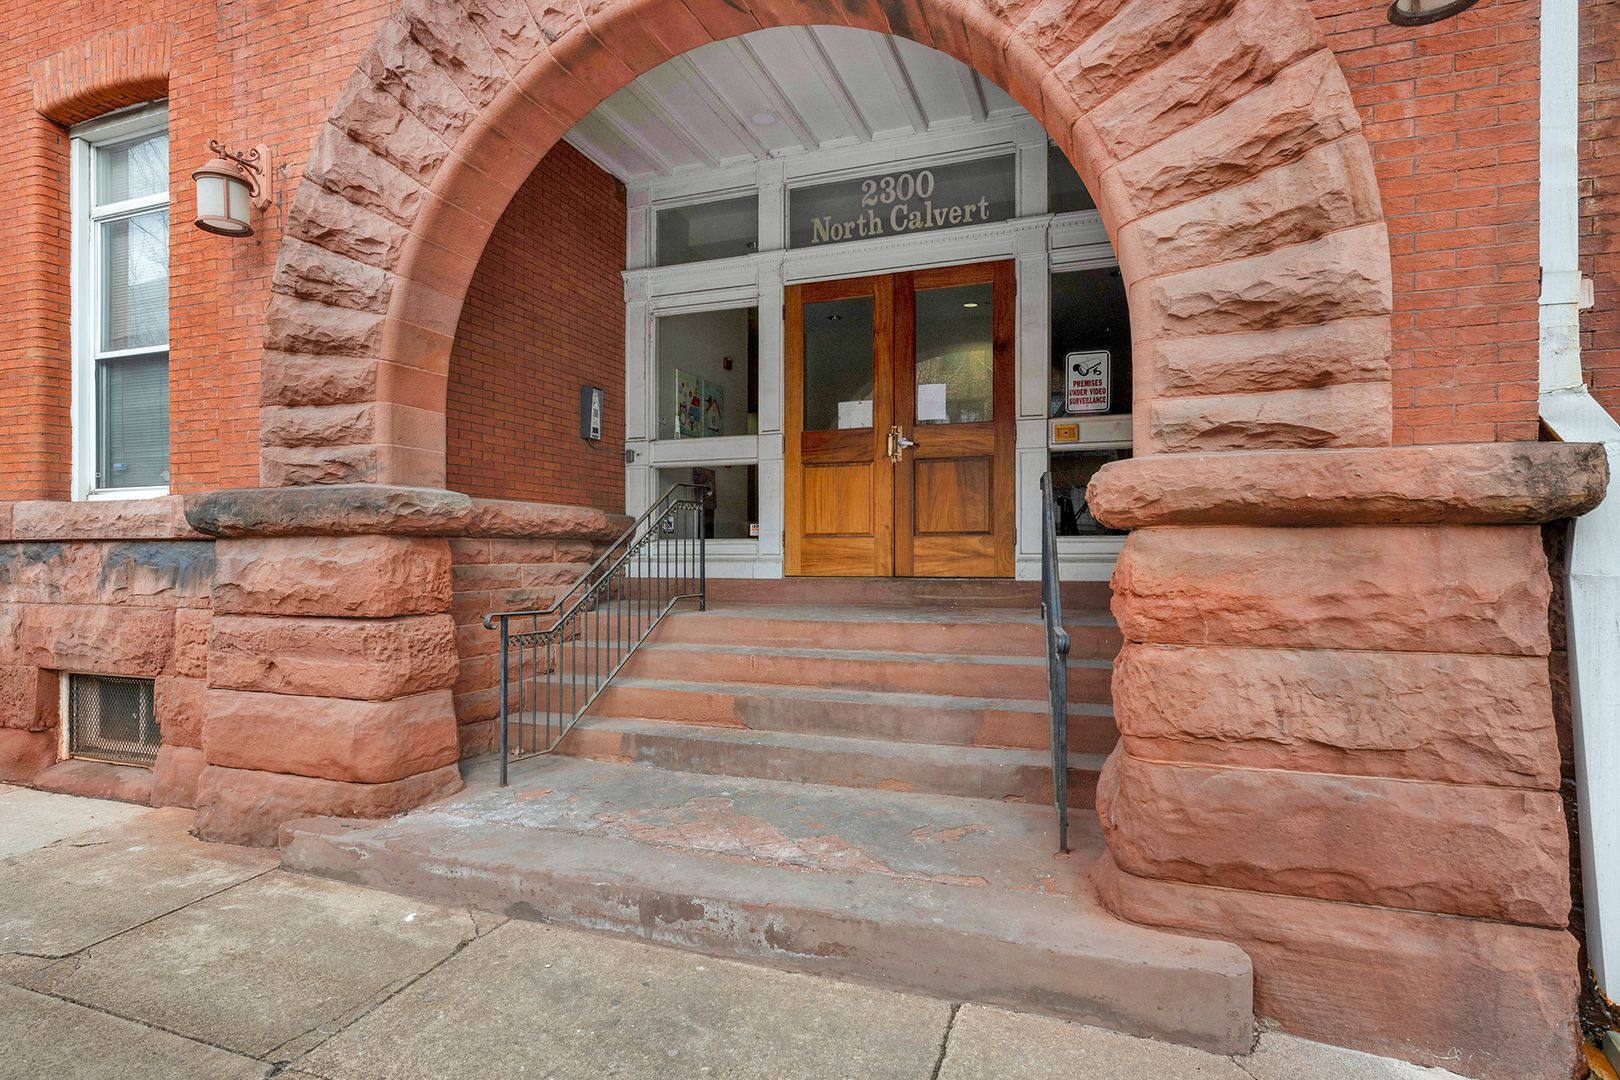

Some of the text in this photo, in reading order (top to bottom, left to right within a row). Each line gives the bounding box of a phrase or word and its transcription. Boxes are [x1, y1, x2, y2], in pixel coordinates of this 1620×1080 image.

[861, 170, 935, 207] 2300
[811, 195, 990, 243] North Calvert
[1072, 379, 1102, 387] PREMISES
[1069, 387, 1106, 396] UNDER VIDEO
[1069, 396, 1106, 405] SURVEILLANCE
